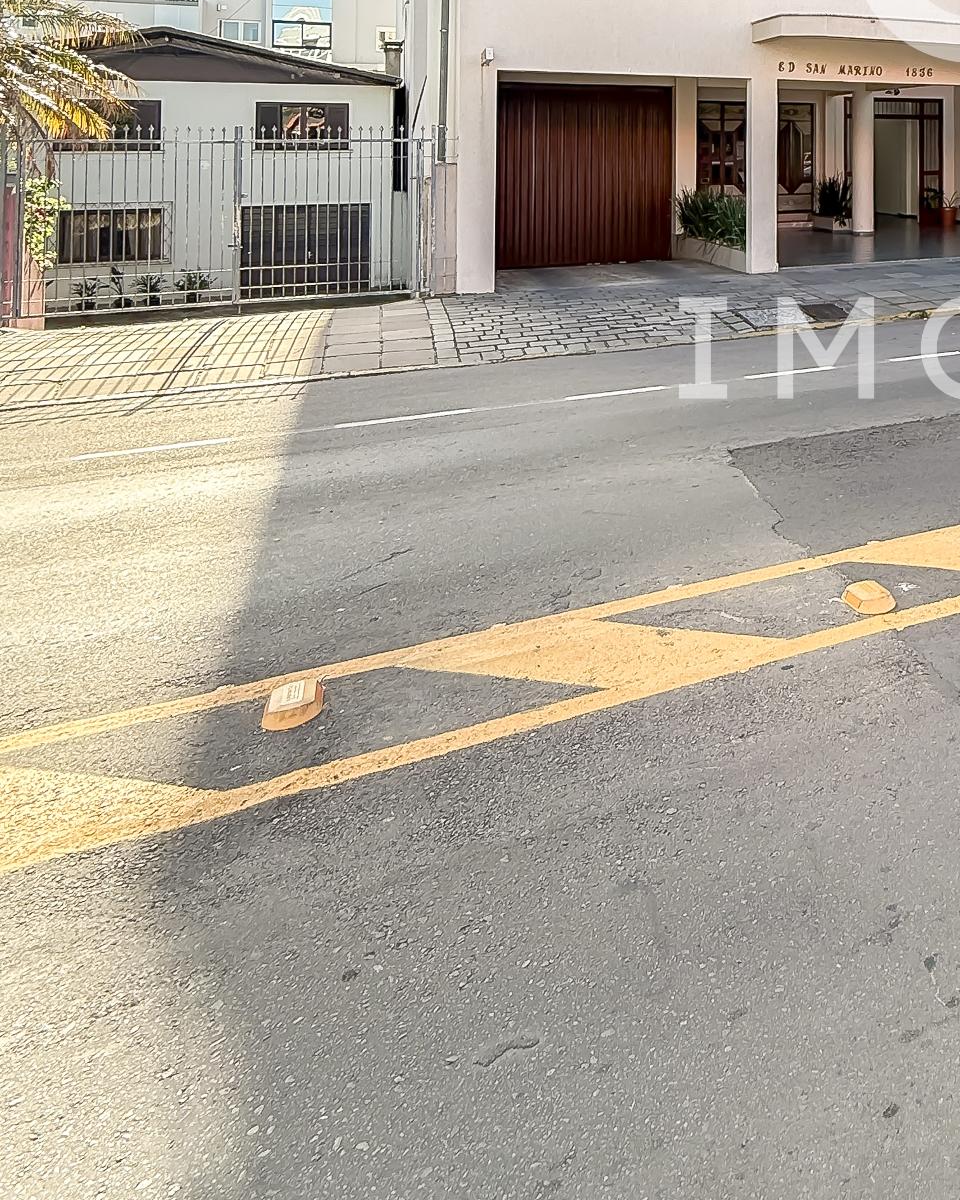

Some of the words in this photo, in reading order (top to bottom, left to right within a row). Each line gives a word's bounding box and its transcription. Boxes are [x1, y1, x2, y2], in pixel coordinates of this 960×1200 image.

[778, 61, 796, 73] ED
[805, 62, 827, 74] SAN
[837, 64, 883, 77] MARINO
